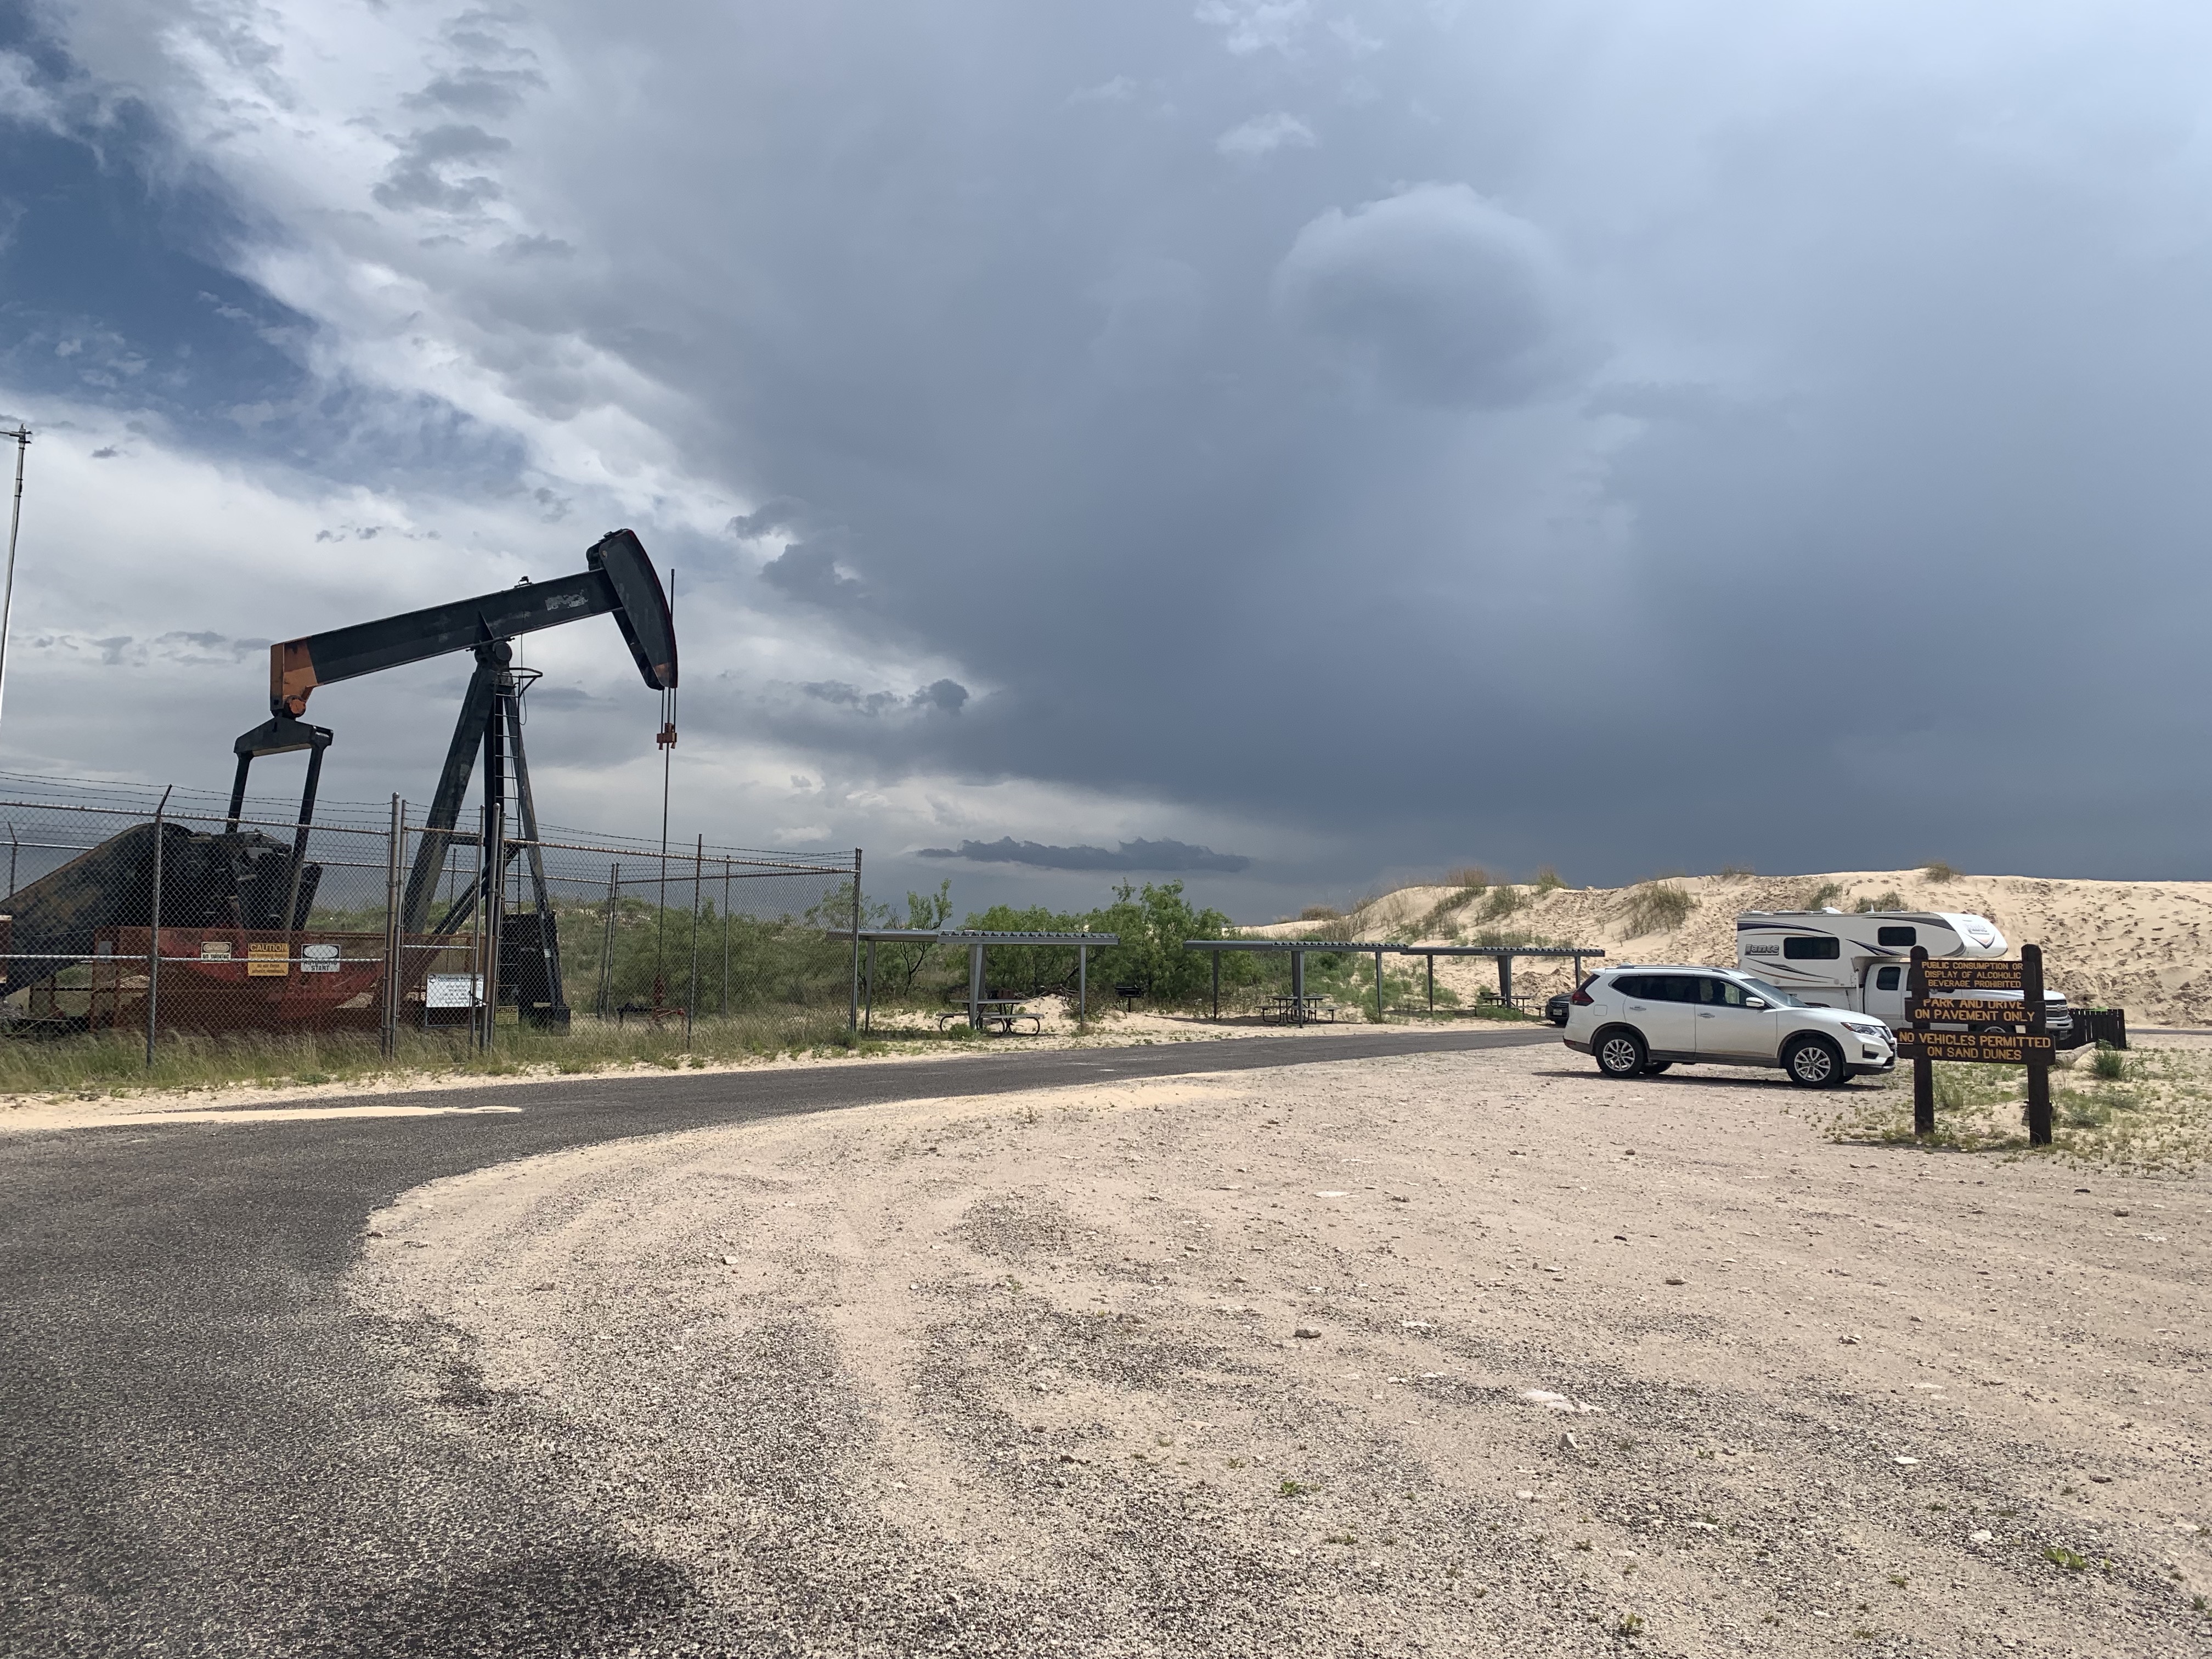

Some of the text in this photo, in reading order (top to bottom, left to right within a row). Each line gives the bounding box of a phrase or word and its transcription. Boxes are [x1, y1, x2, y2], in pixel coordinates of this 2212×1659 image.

[1922, 961, 1949, 969] PUBLIC
[1953, 962, 2008, 970] CONSUMPTION
[1928, 979, 1971, 988] BEVERAGE
[1923, 998, 2025, 1009] PARK AND DRIVE
[1915, 1009, 2035, 1022] ON PAVEMENT ONLY
[1899, 1031, 2051, 1048] NO VEHICLES PERMITTED
[1927, 1046, 2022, 1060] ON SAND DUNES
